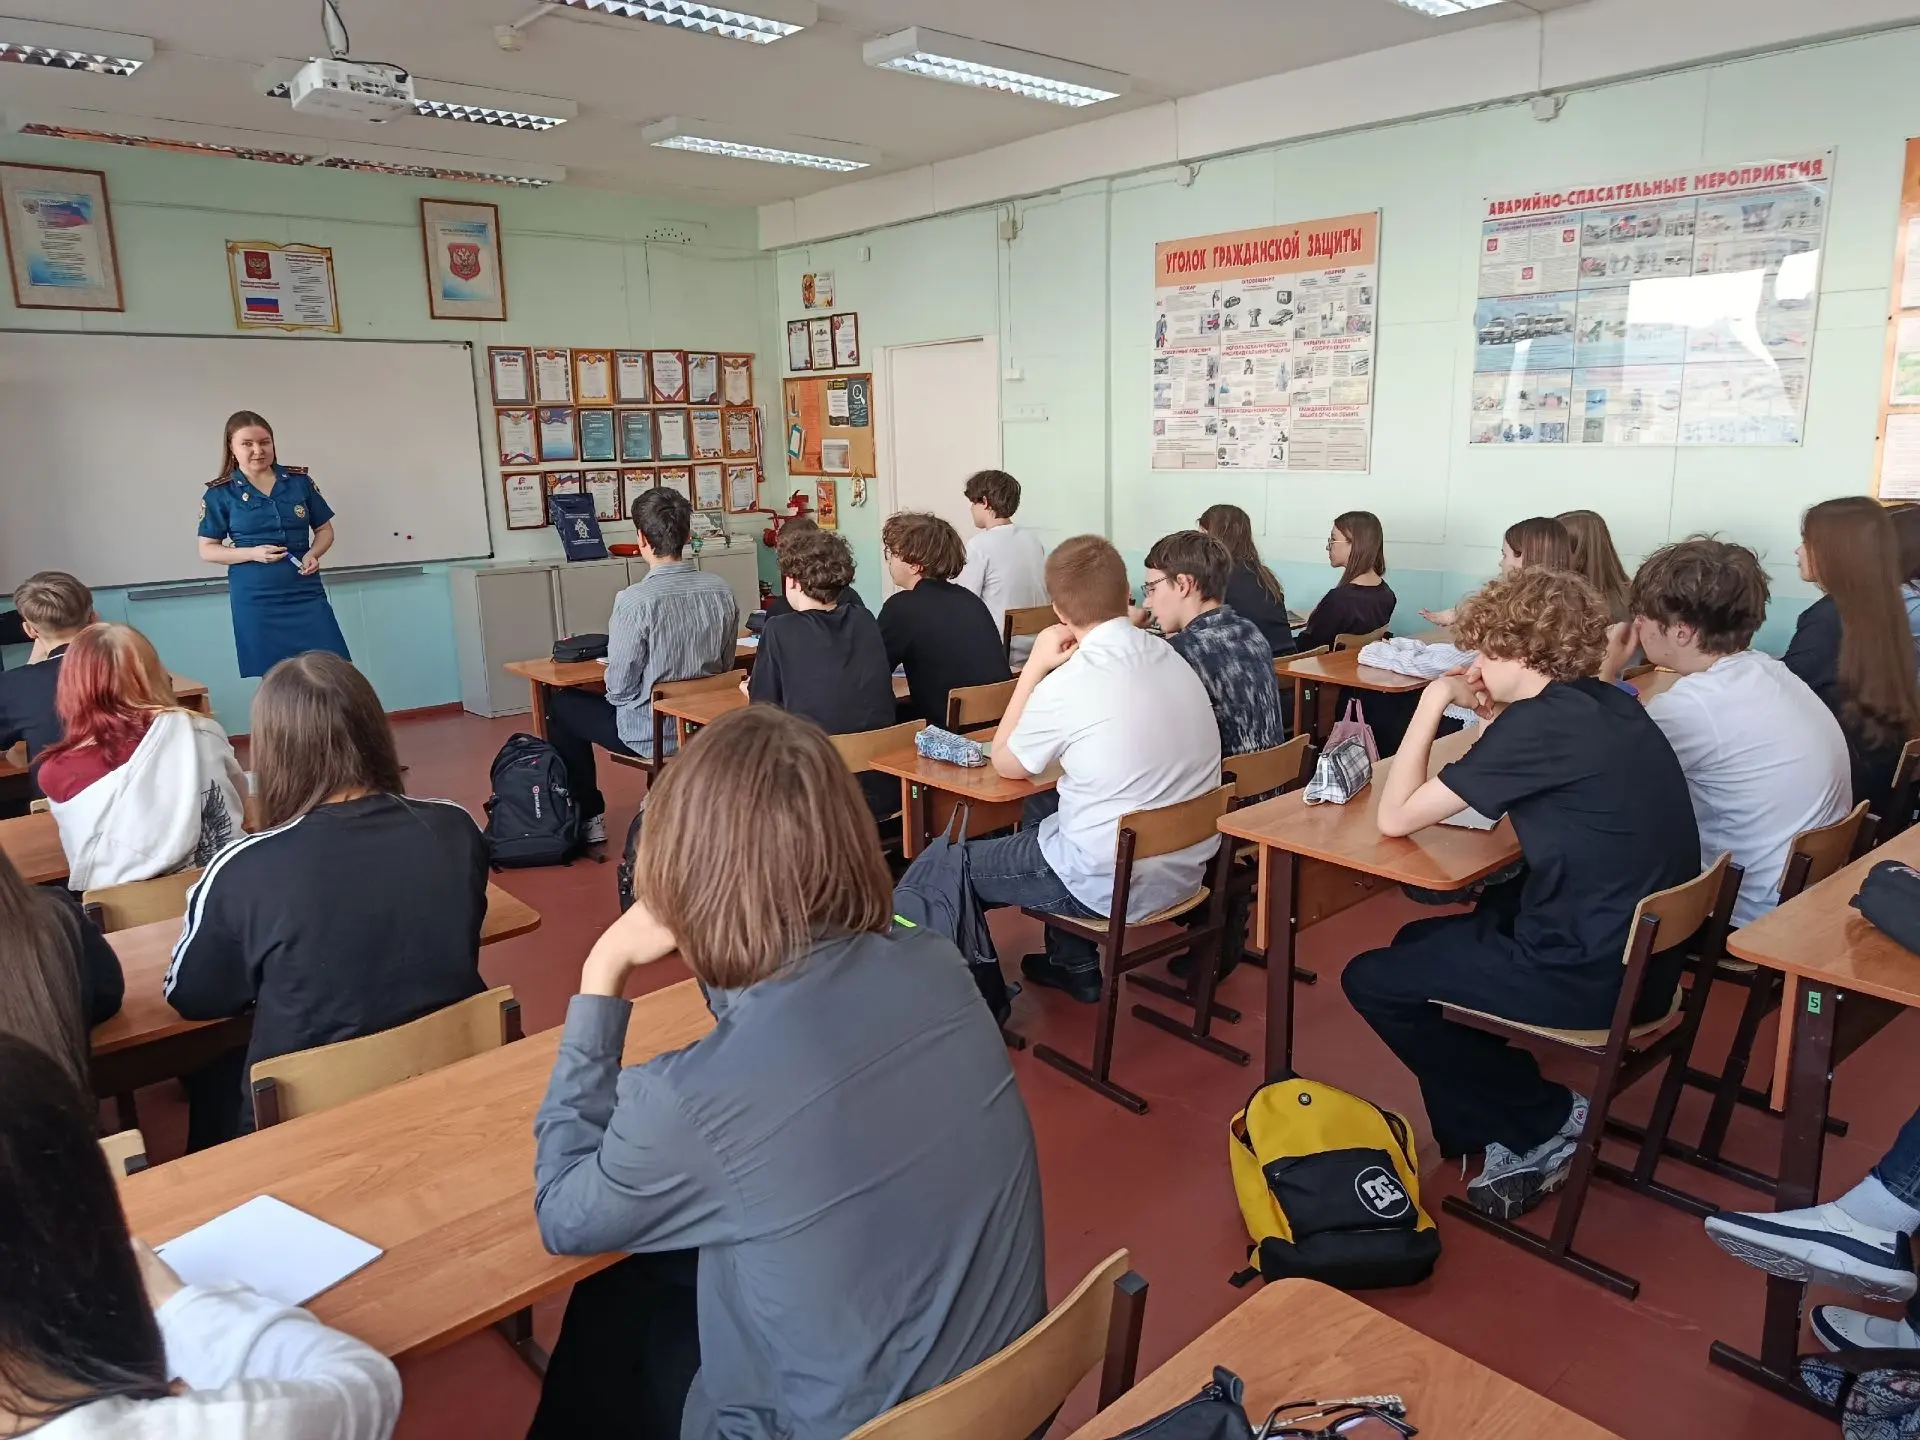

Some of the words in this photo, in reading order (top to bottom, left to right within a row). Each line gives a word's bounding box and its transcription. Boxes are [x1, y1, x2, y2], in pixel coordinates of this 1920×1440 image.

[1488, 176, 1688, 215] АВАРИЙНО-СПАСАТЕЛЬНЫЕ
[1694, 158, 1823, 190] МЕРОПРИЯТИЯ
[1166, 248, 1206, 274] УГОЛОК
[1212, 230, 1300, 269] ГРАЖДАНСКОЙ
[1307, 228, 1361, 259] ЗАЩИТЫ
[1810, 997, 1819, 1008] 5
